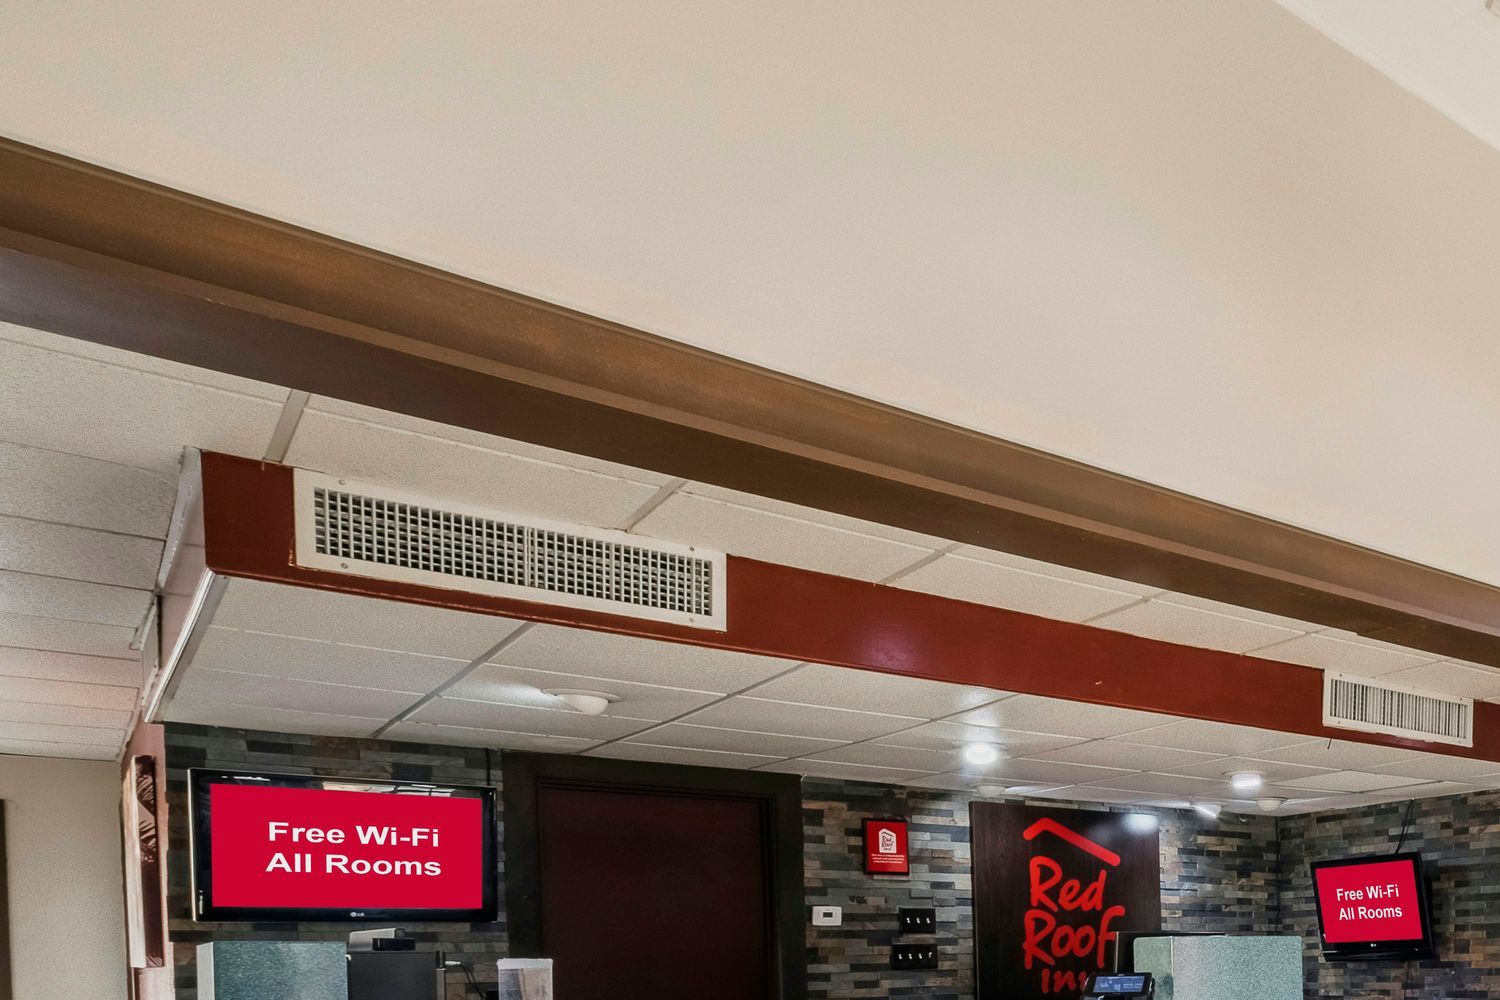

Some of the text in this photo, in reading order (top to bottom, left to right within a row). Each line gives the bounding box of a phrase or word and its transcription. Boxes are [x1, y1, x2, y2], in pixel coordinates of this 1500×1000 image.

[268, 821, 440, 848] Free Wi-Fi
[265, 852, 442, 877] All Rooms
[1028, 855, 1107, 912] Red
[1336, 884, 1400, 902] Free Wi-Fi
[1338, 905, 1403, 921] All Rooms
[1022, 905, 1126, 969] Roof
